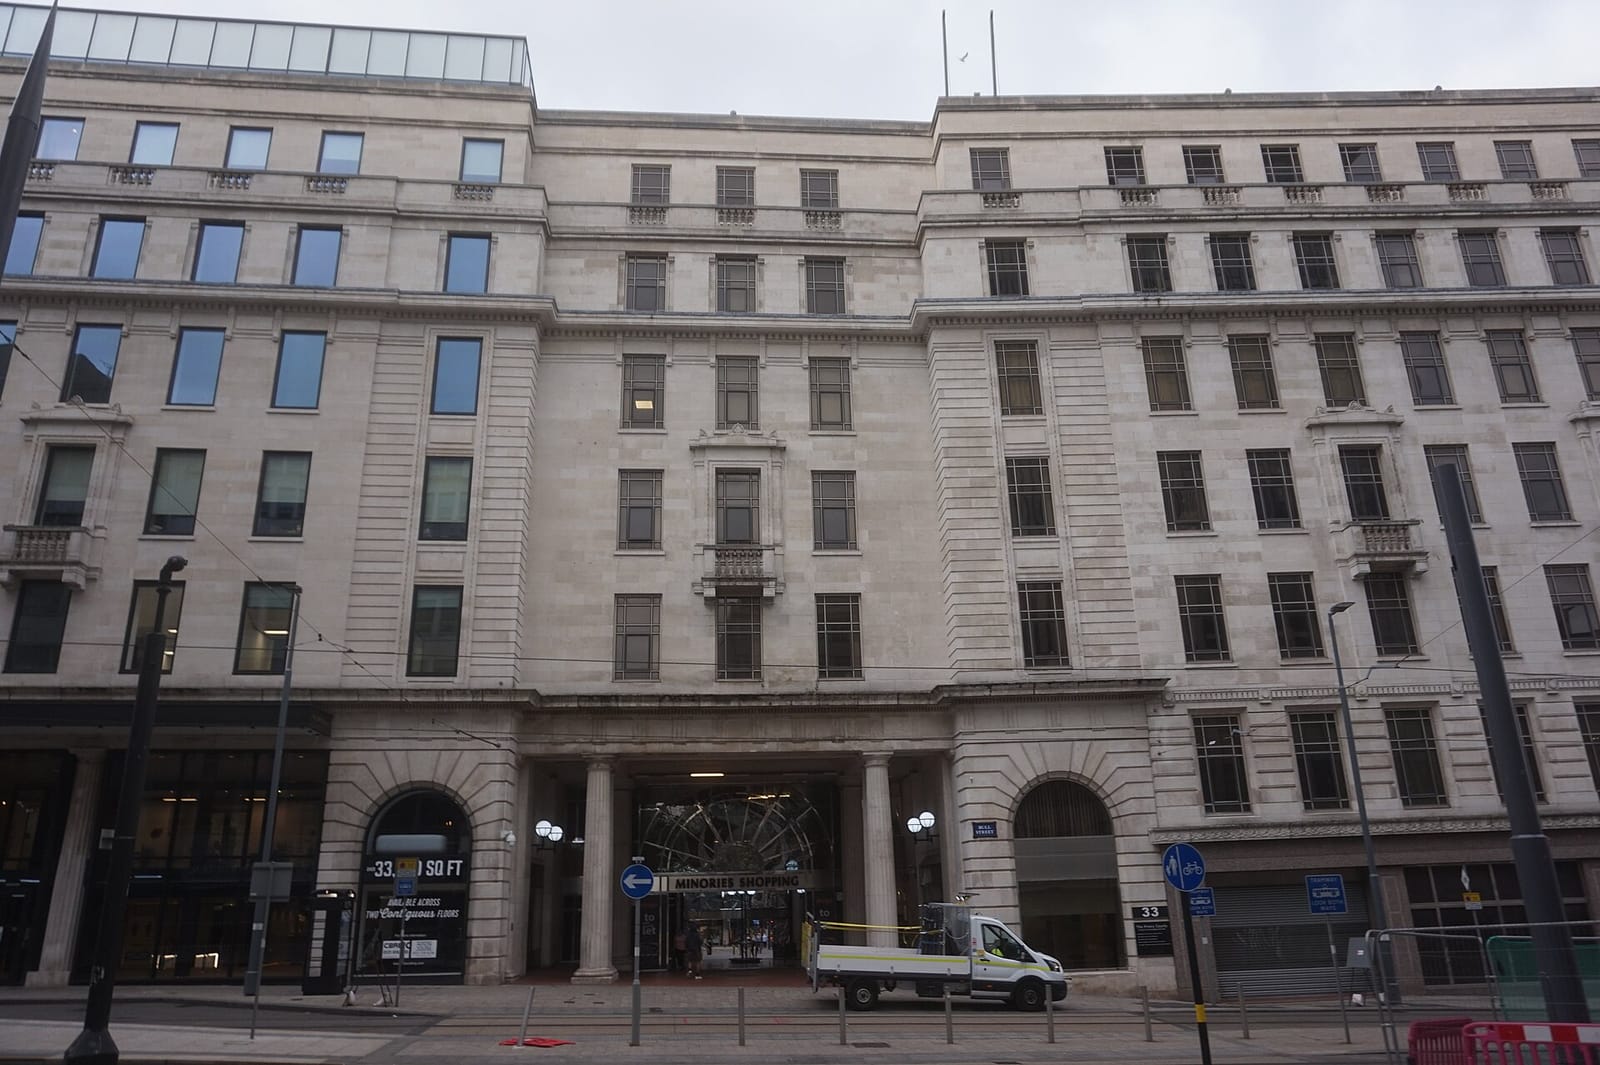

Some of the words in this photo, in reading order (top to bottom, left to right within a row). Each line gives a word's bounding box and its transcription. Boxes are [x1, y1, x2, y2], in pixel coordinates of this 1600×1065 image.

[374, 860, 422, 877] 33,0
[426, 860, 444, 876] SQ
[447, 860, 463, 876] FT
[675, 876, 734, 889] MINORIES
[739, 875, 799, 888] SHOPPING
[417, 898, 441, 906] ACROSS
[366, 910, 379, 919] TWO
[437, 910, 459, 918] FLOORS
[1141, 907, 1159, 917] 33
[644, 913, 655, 921] to
